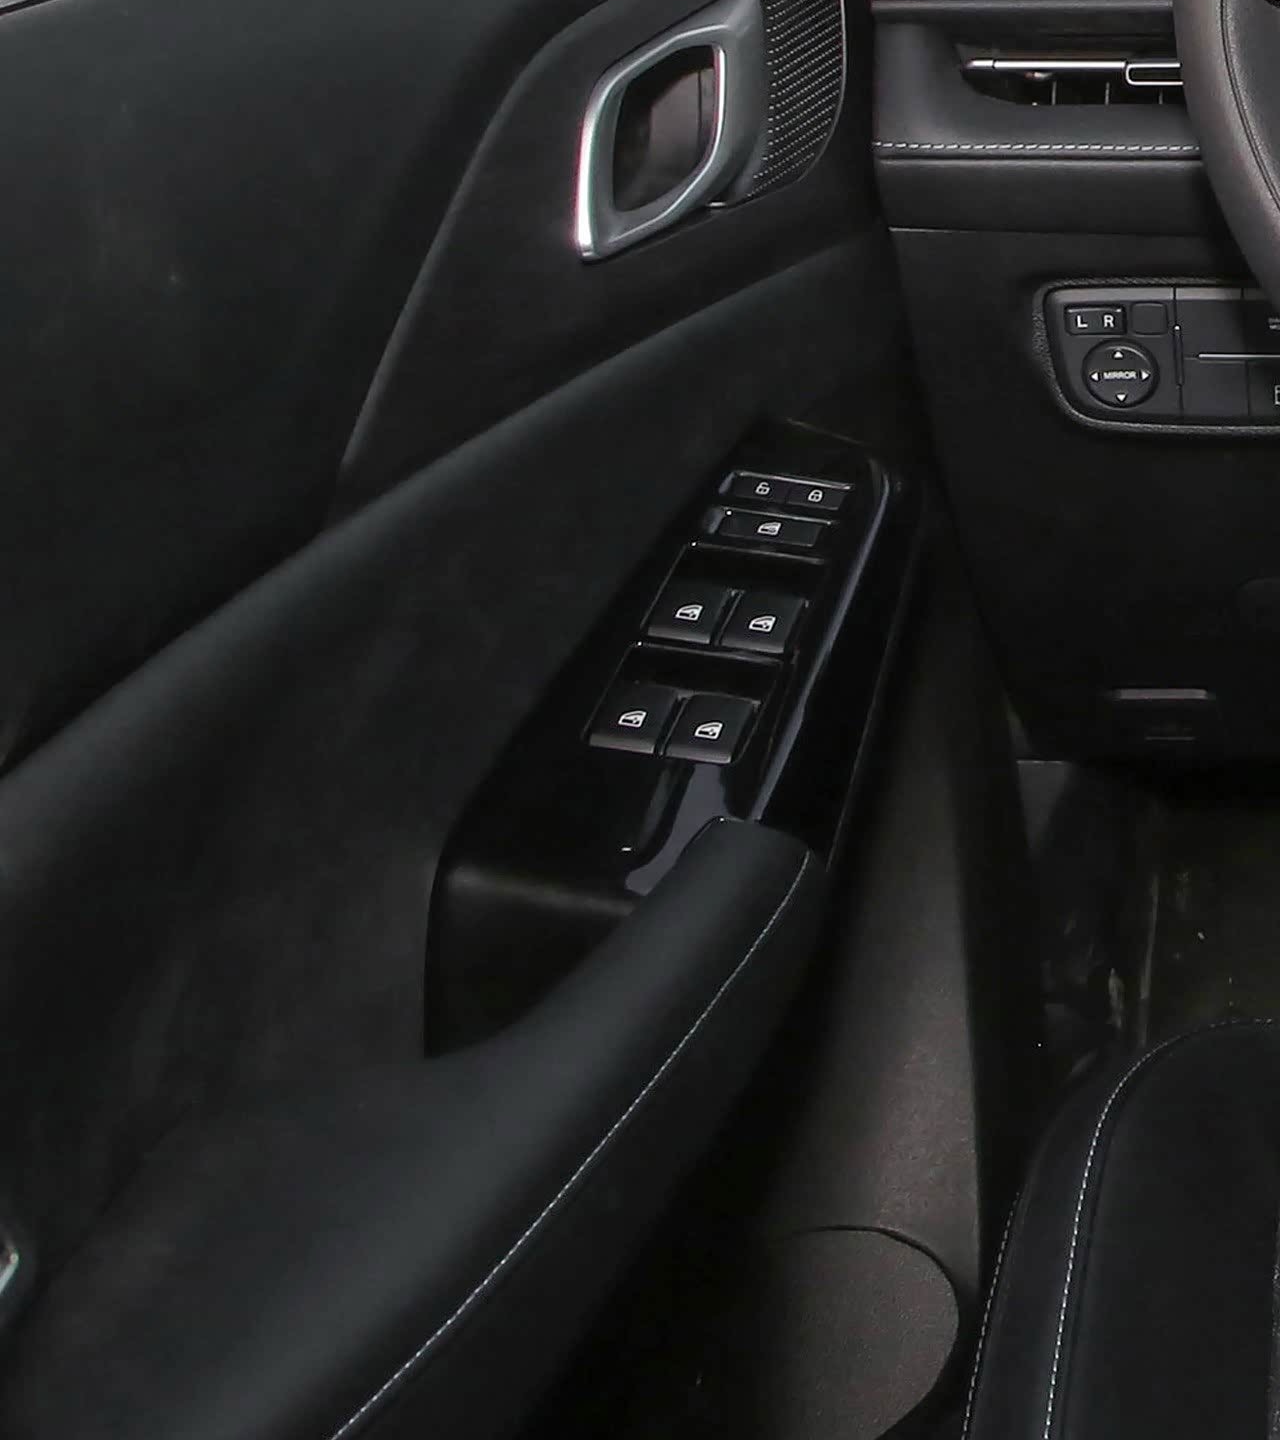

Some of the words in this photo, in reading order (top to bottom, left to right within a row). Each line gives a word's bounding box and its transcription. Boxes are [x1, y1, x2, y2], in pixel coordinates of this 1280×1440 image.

[1076, 315, 1088, 328] L
[1103, 315, 1115, 328] R
[1103, 370, 1137, 380] MIRROR
